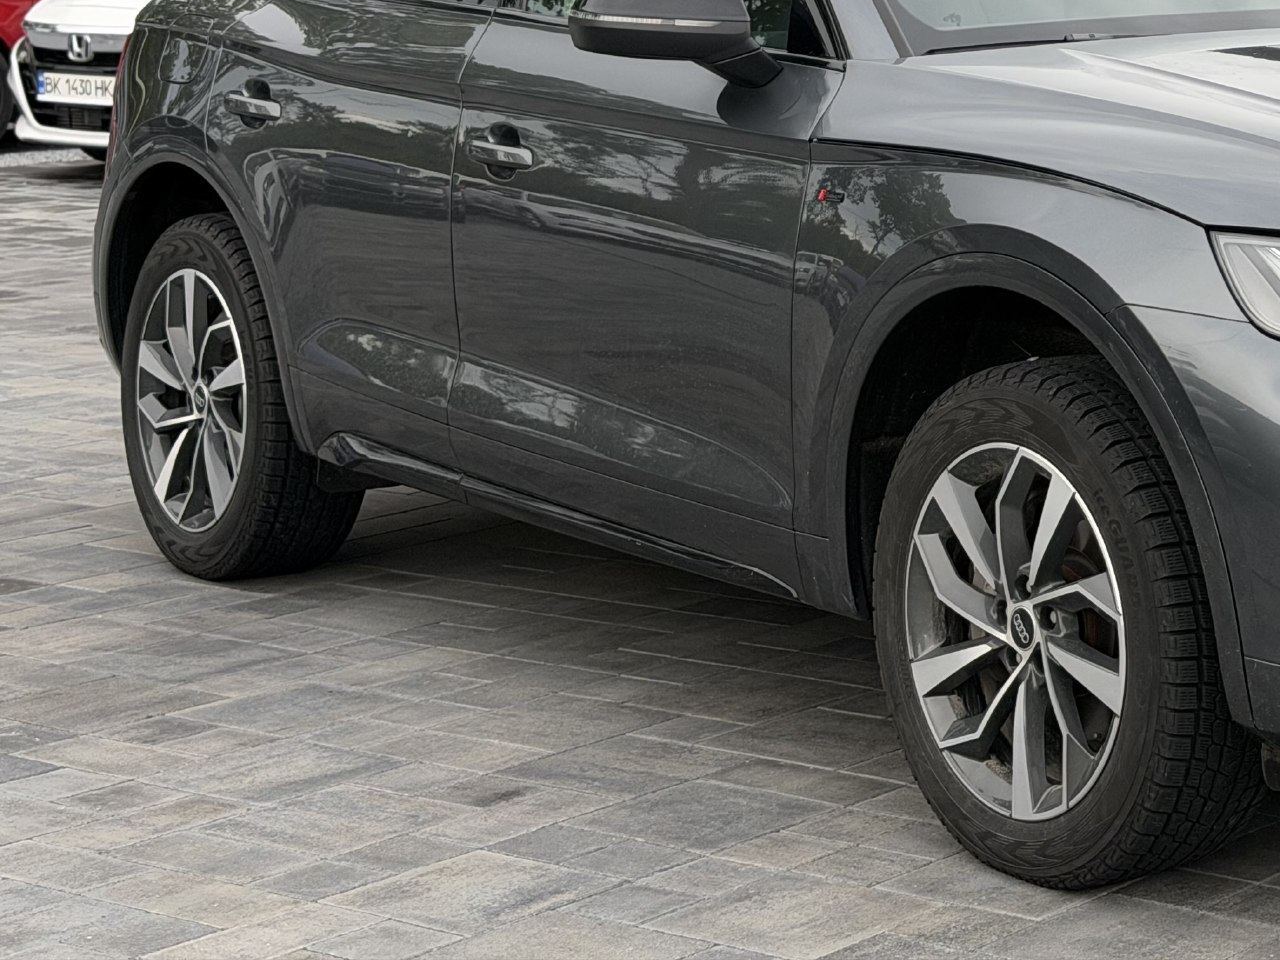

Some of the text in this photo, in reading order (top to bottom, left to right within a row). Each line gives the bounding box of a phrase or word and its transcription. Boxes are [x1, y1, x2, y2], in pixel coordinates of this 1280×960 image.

[45, 77, 113, 97] BK 1430 HK
